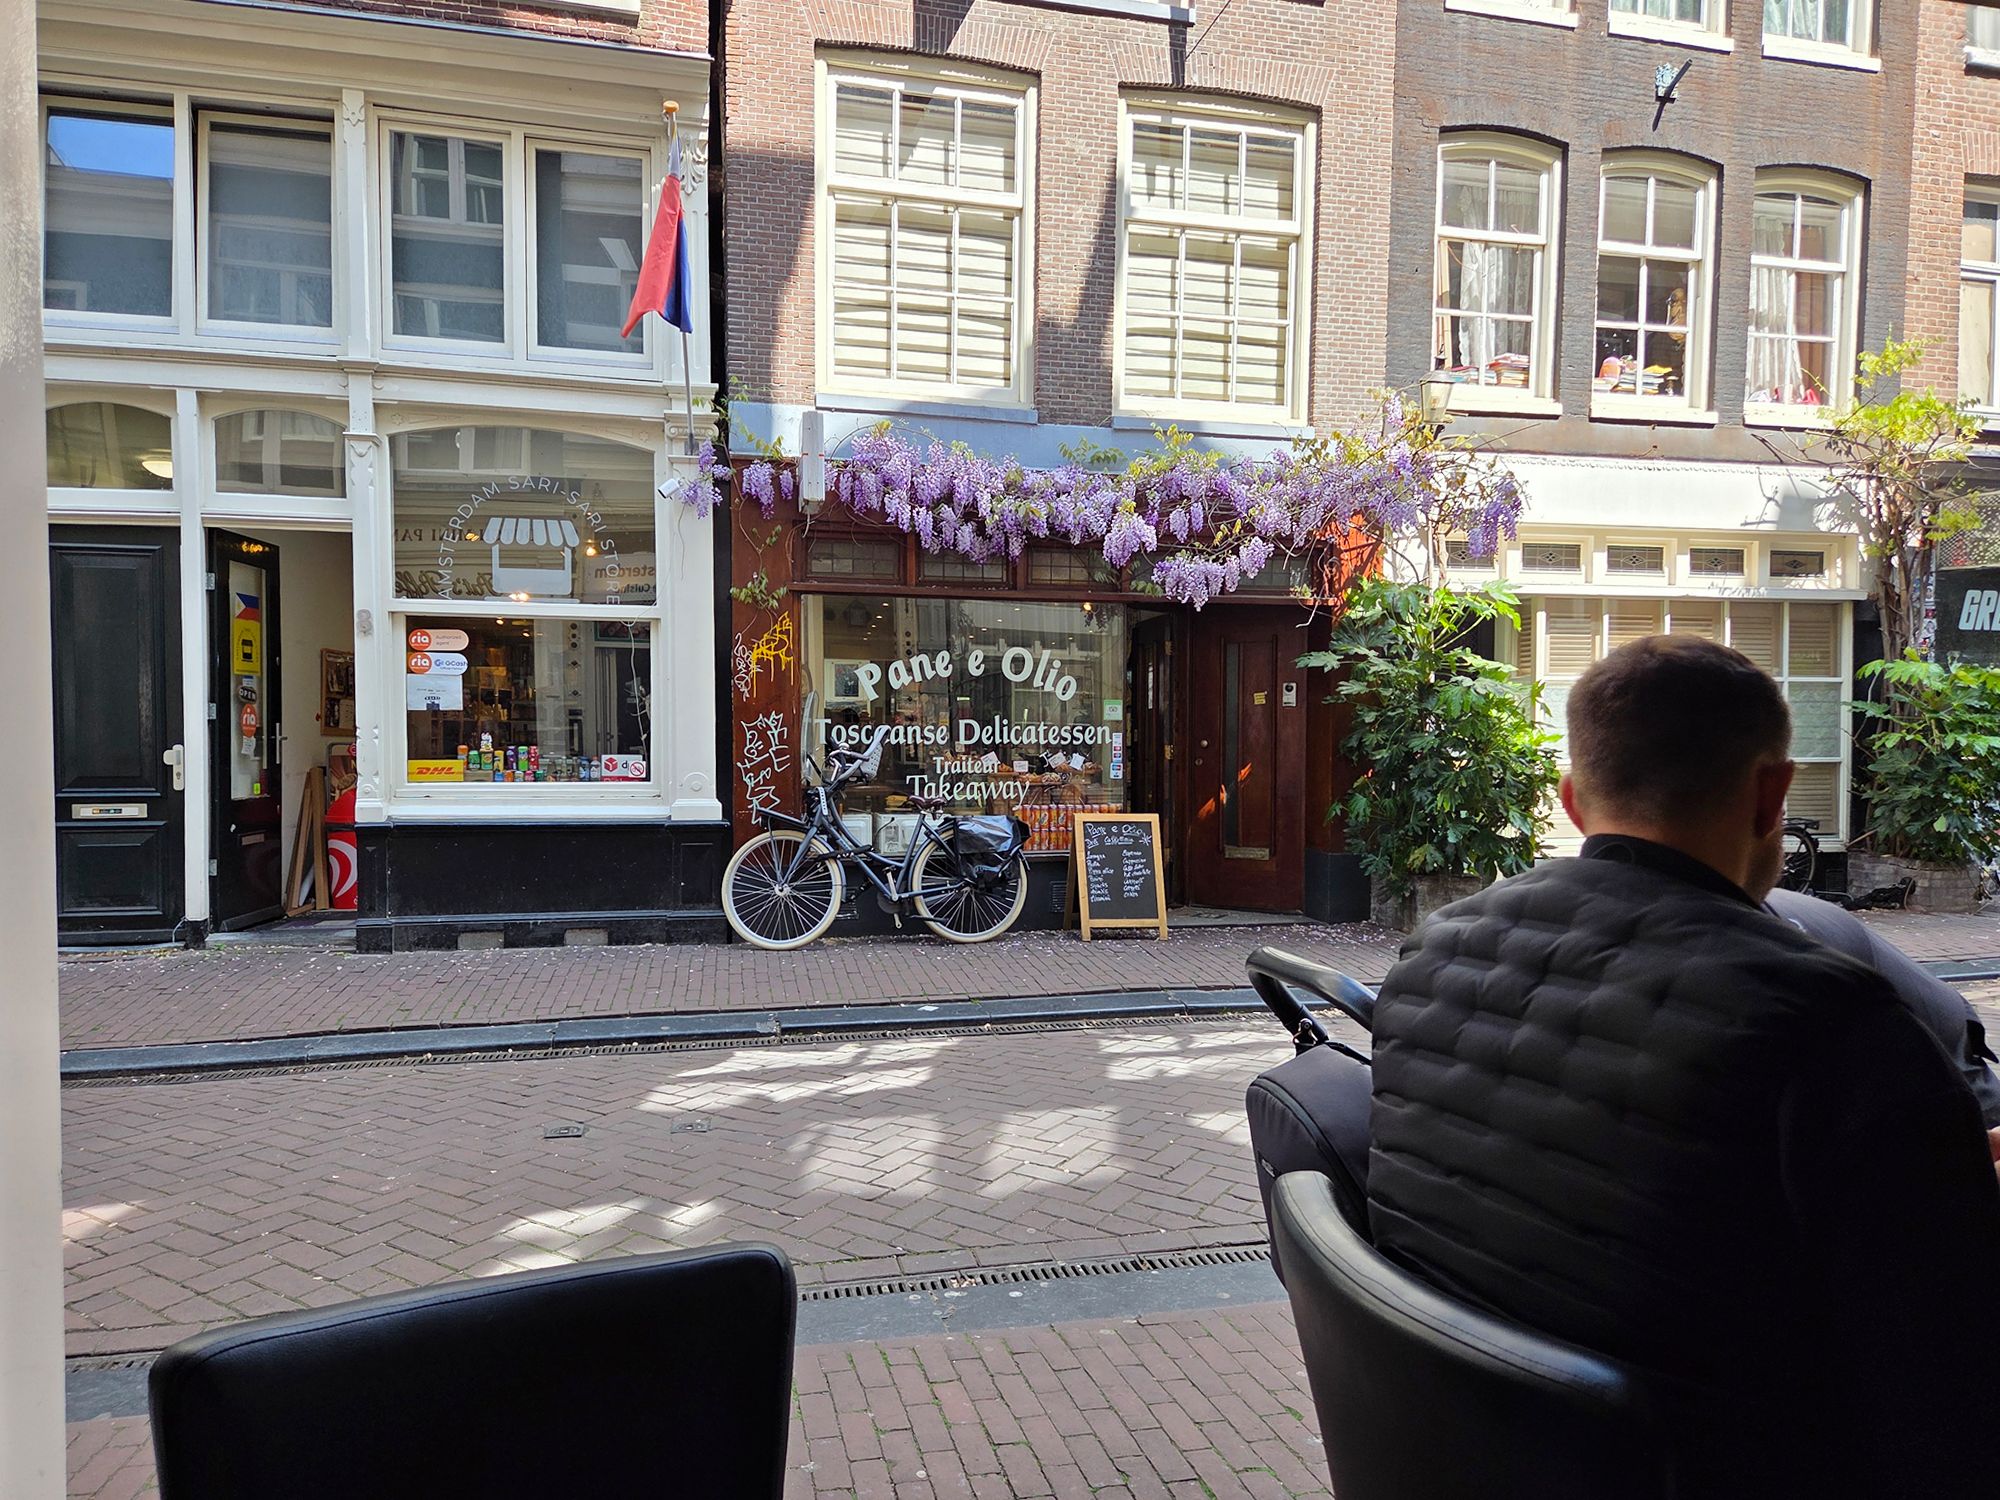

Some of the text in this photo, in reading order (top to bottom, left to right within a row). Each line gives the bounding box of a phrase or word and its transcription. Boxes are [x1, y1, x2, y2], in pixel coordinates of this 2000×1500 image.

[438, 476, 621, 605] AMSTERDAM SARI-SARI STORE
[411, 631, 429, 643] ria
[411, 654, 429, 666] ria
[853, 650, 953, 701] Pane
[968, 649, 985, 677] e
[1001, 646, 1077, 702] Olio
[239, 688, 256, 700] OPEN
[242, 707, 256, 724] ria
[815, 715, 1113, 746] Toscanse Delicatessen
[416, 766, 456, 775] DHL
[933, 756, 1001, 775] Traiteur
[906, 773, 1029, 810] Takeaway
